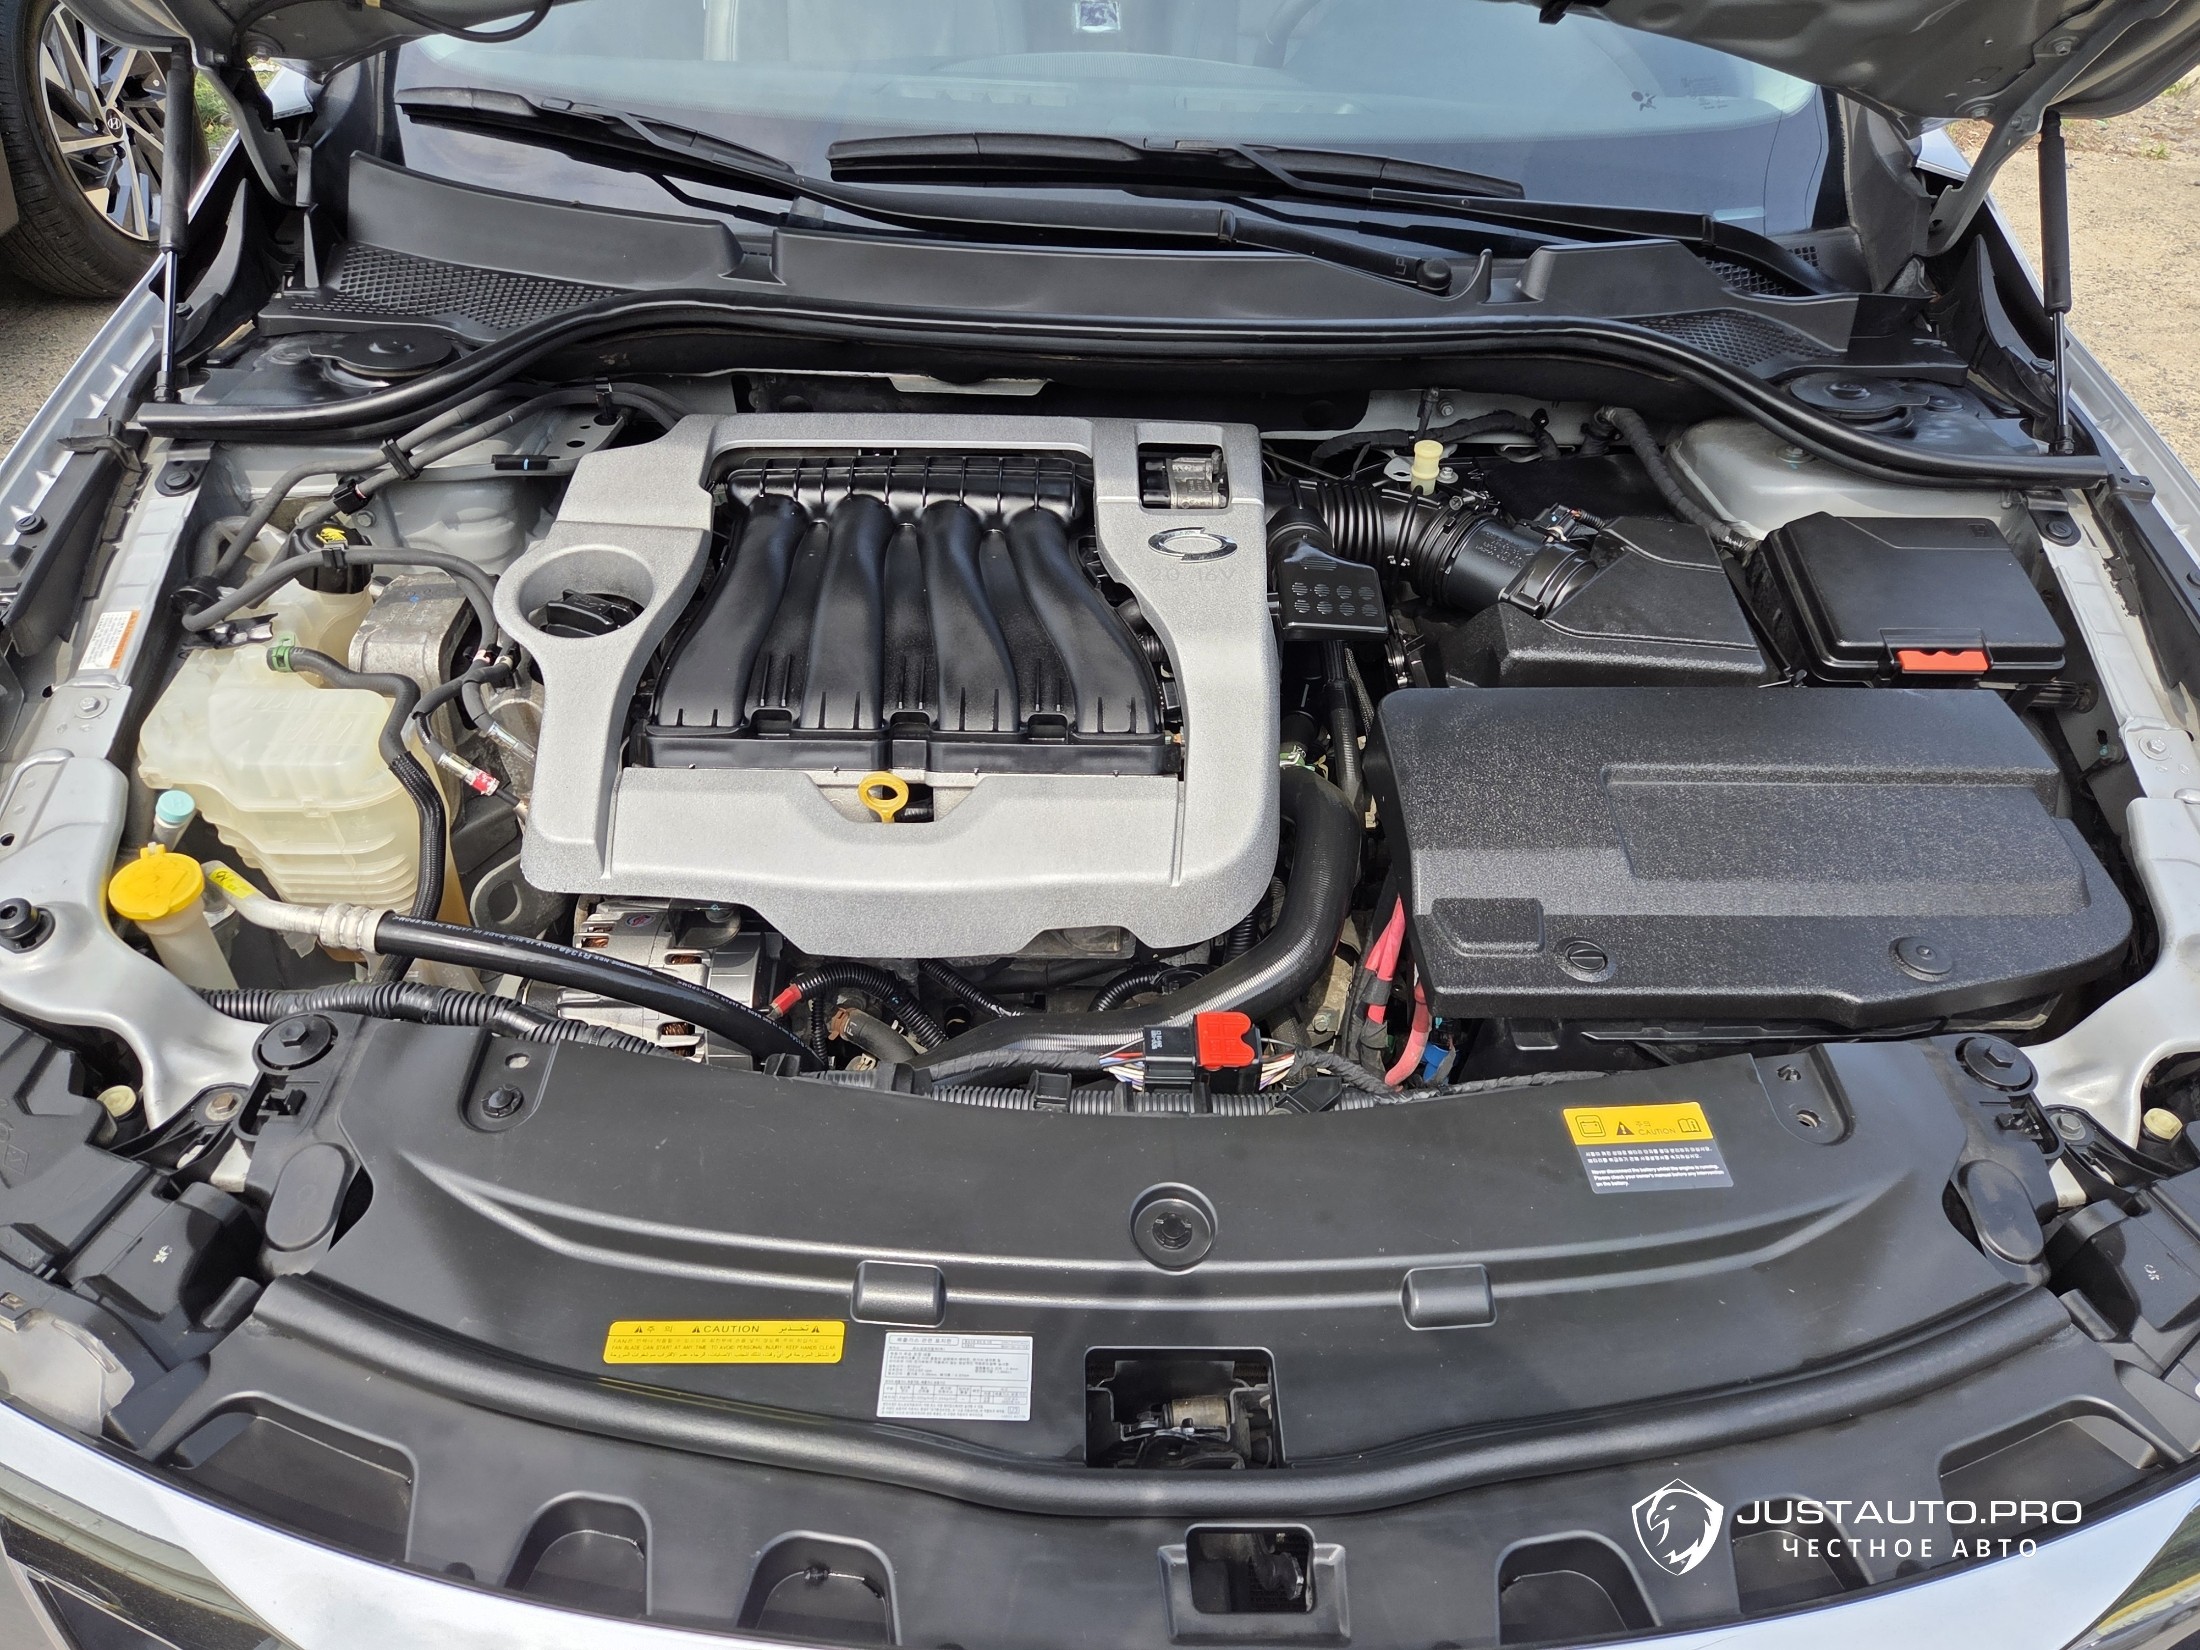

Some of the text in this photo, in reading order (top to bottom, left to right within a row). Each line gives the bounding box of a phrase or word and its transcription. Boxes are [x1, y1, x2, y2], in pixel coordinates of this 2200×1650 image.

[446, 924, 472, 932] JAPAN
[484, 931, 506, 940] MADE
[1638, 1128, 1676, 1136] CAUTION
[703, 1325, 760, 1333] CAUTION
